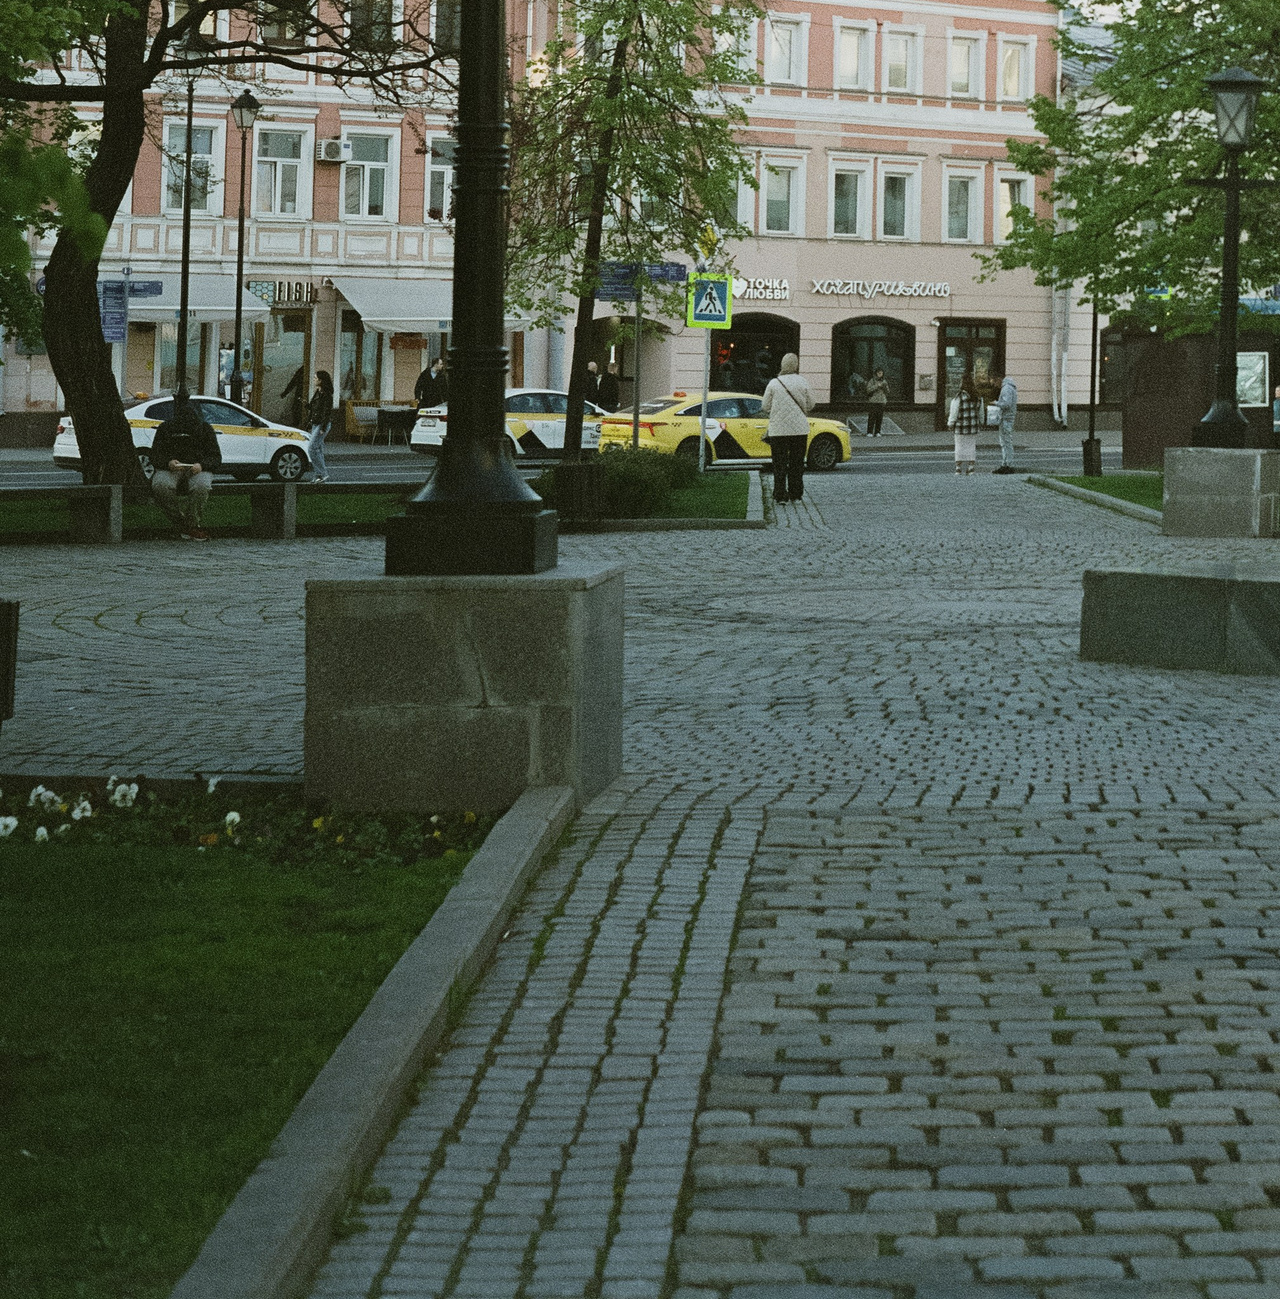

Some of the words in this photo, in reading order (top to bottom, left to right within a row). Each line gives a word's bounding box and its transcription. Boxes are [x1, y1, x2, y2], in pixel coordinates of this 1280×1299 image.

[748, 278, 790, 288] ТОЧКА
[275, 281, 313, 302] FISH
[744, 289, 790, 299] ЛЮБВИ
